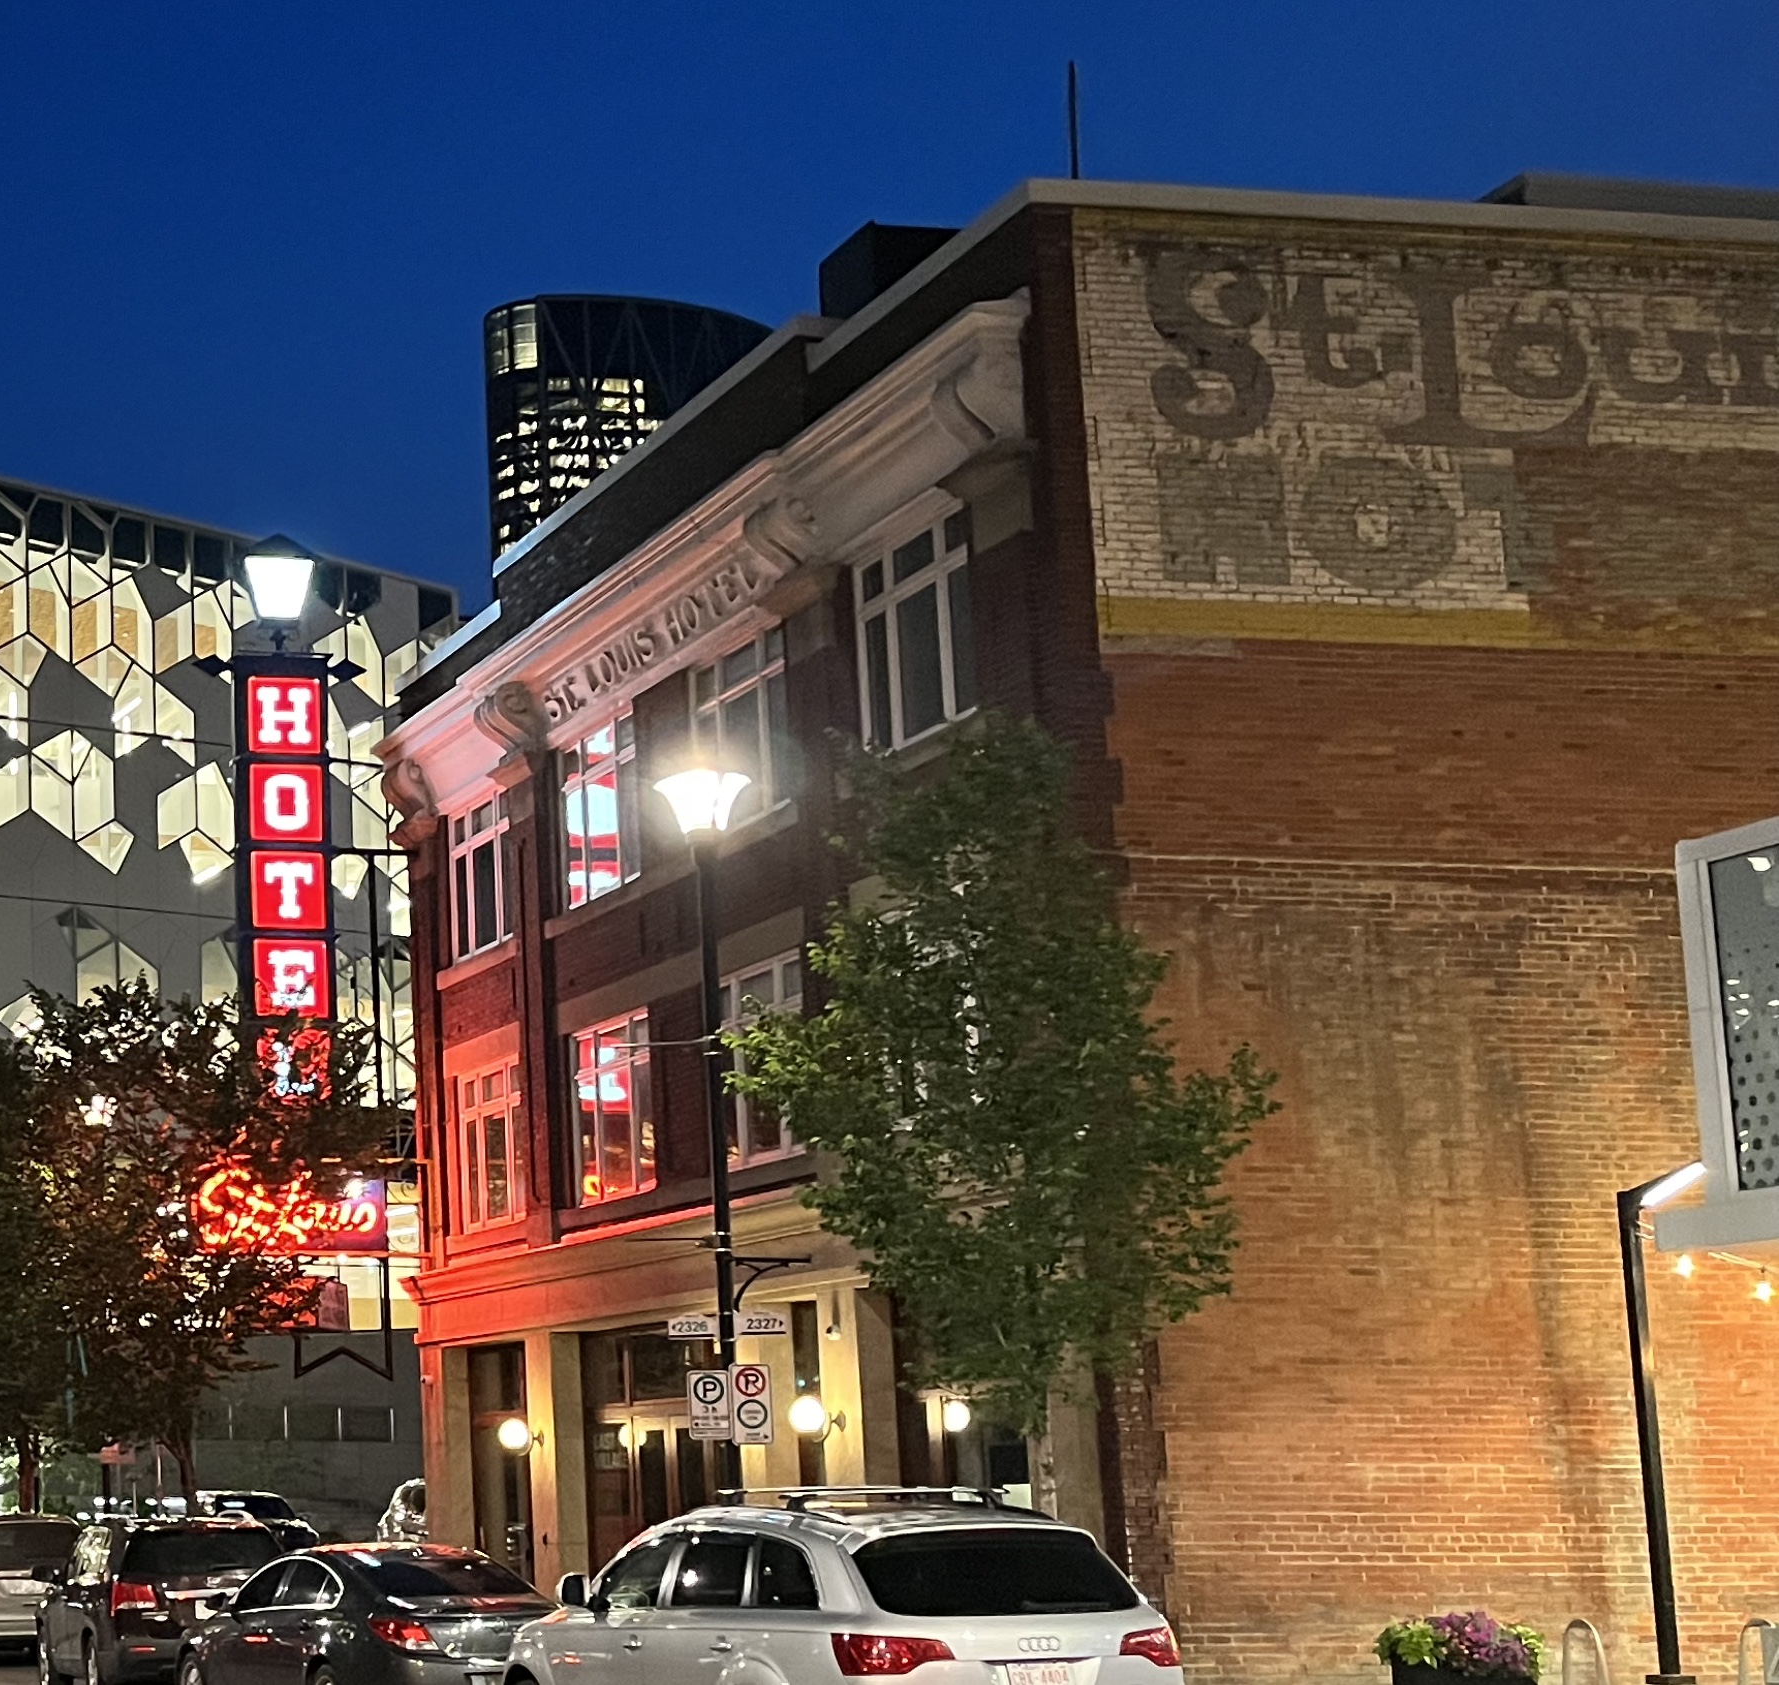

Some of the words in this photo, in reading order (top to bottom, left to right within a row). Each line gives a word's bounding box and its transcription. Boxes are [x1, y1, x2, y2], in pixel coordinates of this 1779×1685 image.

[1383, 250, 1779, 447] Loui
[584, 630, 656, 693] LOUIS
[663, 562, 760, 648] HOTEL
[257, 685, 317, 1097] HOTEL
[677, 1321, 708, 1333] 2326
[746, 1318, 778, 1330] 2327
[702, 1381, 718, 1398] P
